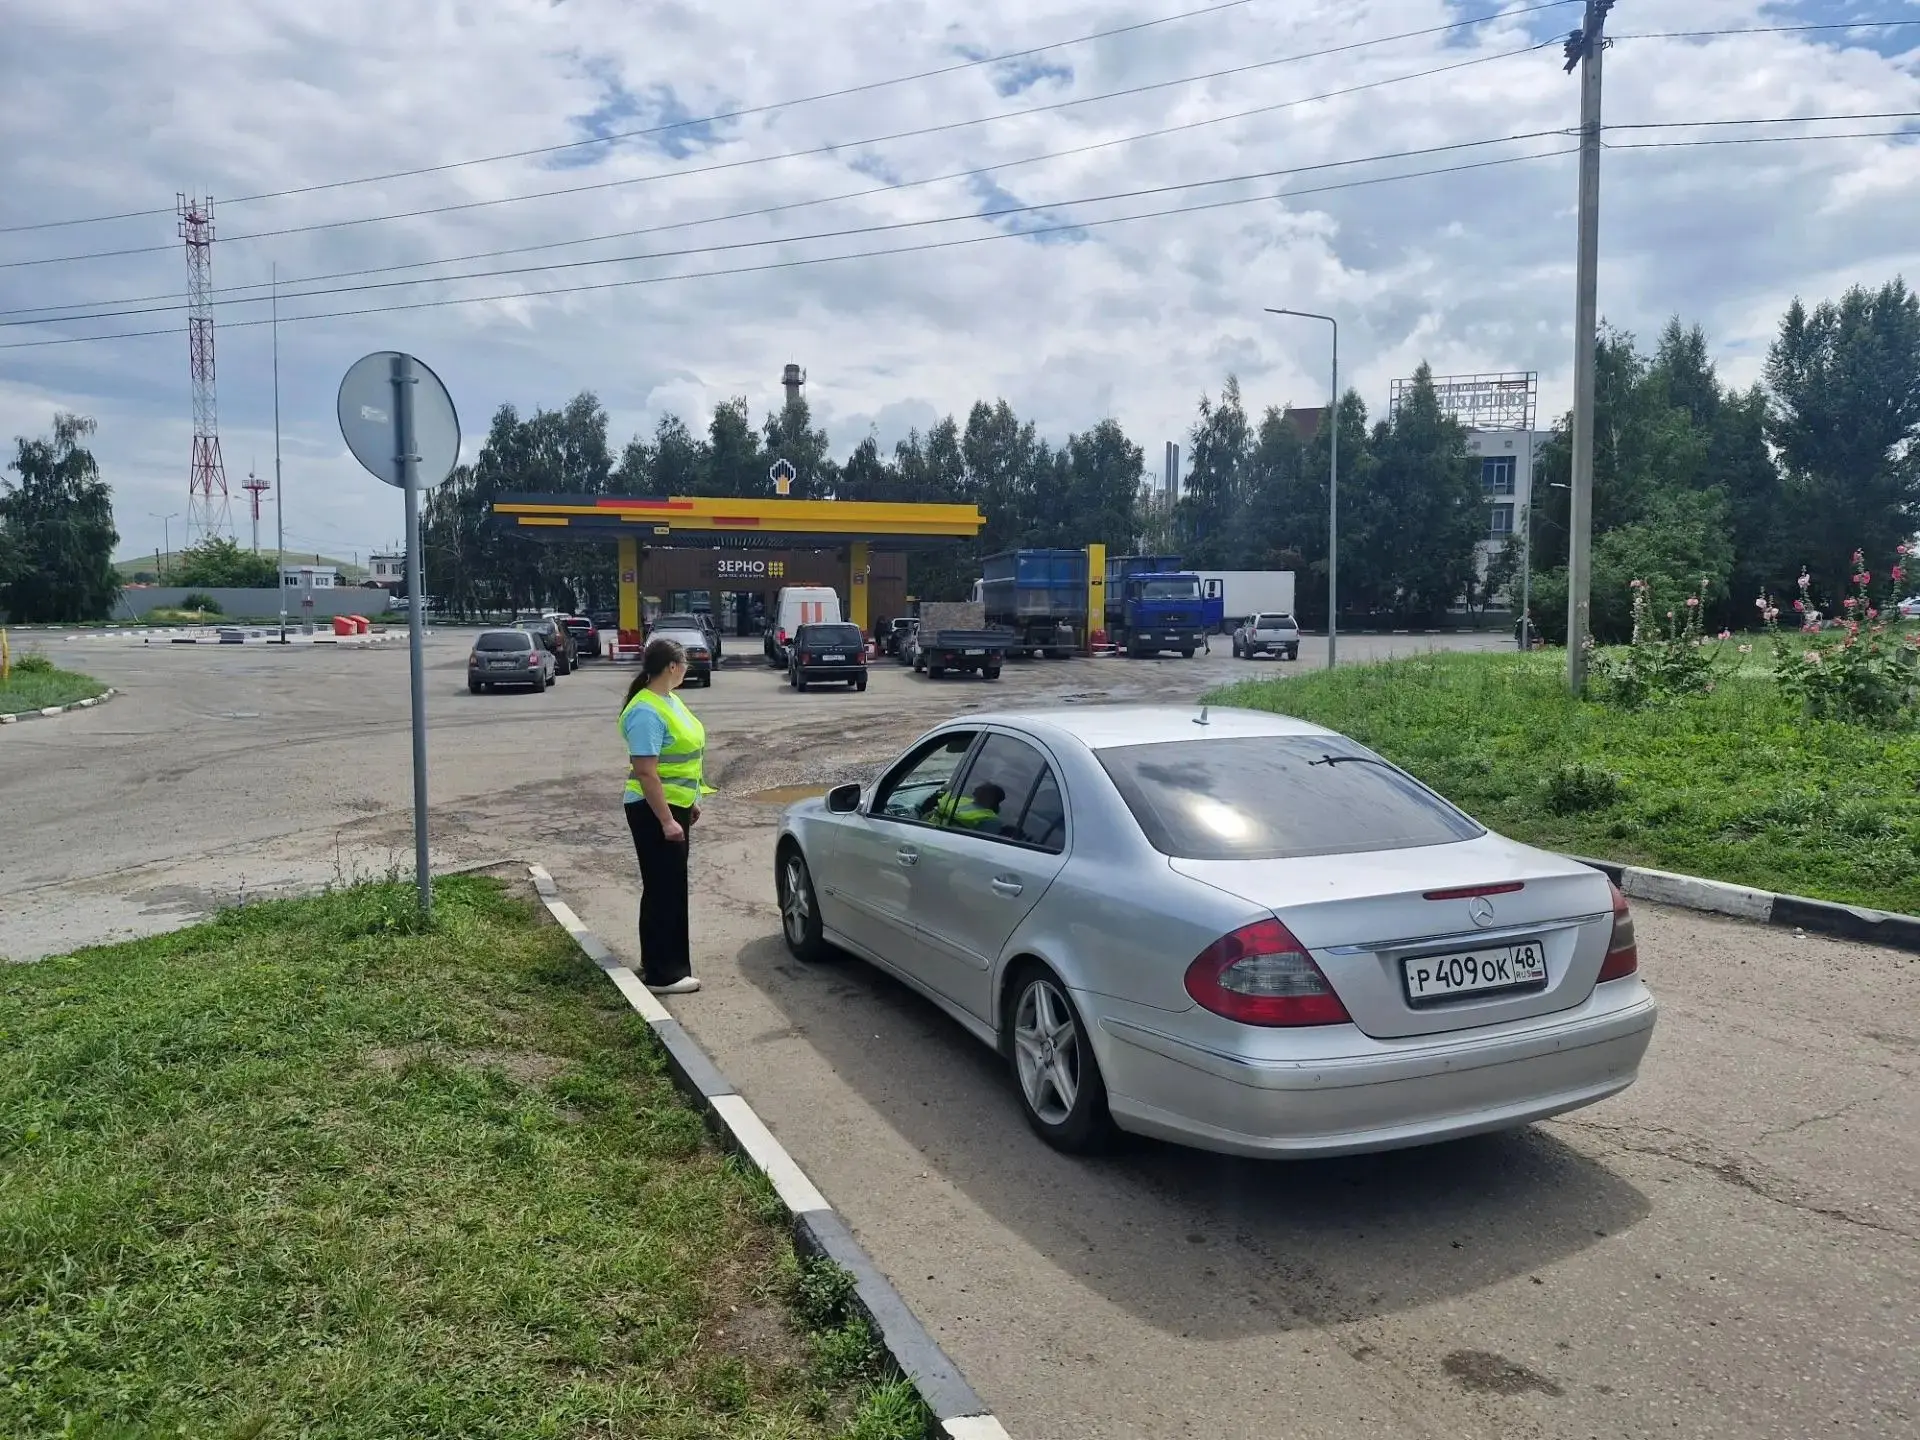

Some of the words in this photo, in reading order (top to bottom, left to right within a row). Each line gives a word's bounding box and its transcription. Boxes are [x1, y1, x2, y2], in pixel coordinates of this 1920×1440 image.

[718, 560, 765, 572] ЗЕРНО
[1515, 946, 1536, 970] 48
[1516, 970, 1532, 979] RUS
